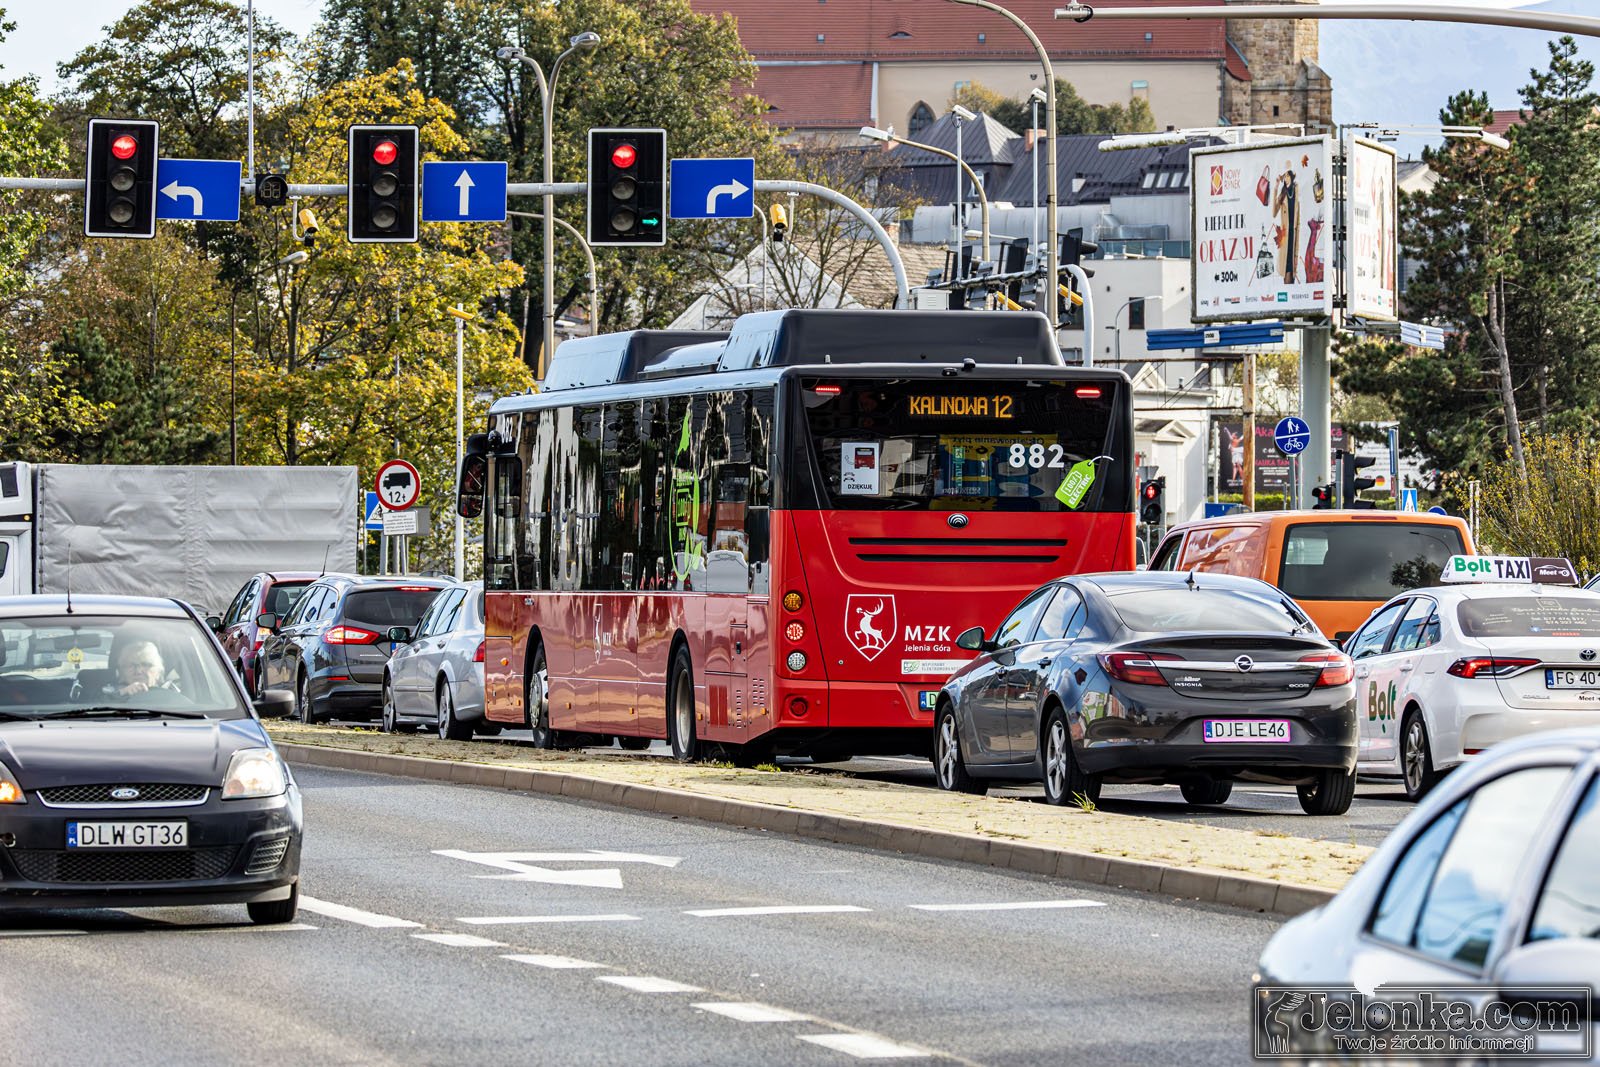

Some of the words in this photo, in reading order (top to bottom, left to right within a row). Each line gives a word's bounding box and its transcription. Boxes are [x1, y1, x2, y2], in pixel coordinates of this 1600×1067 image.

[1200, 236, 1253, 263] OKAZJI
[909, 396, 988, 415] KALINOWA
[992, 395, 1013, 418] 12
[1008, 443, 1065, 468] 882
[1069, 474, 1092, 505] ELECTRIC
[1454, 558, 1491, 577] Bolt
[1494, 560, 1530, 579] TAXI
[905, 626, 951, 641] MZK
[933, 644, 951, 652] Góra
[1556, 672, 1575, 684] FG
[1369, 680, 1396, 733] Bolt
[1215, 722, 1244, 738] DJE
[1249, 722, 1286, 738] LE46
[81, 825, 126, 845] DLW
[132, 825, 183, 845] GT36
